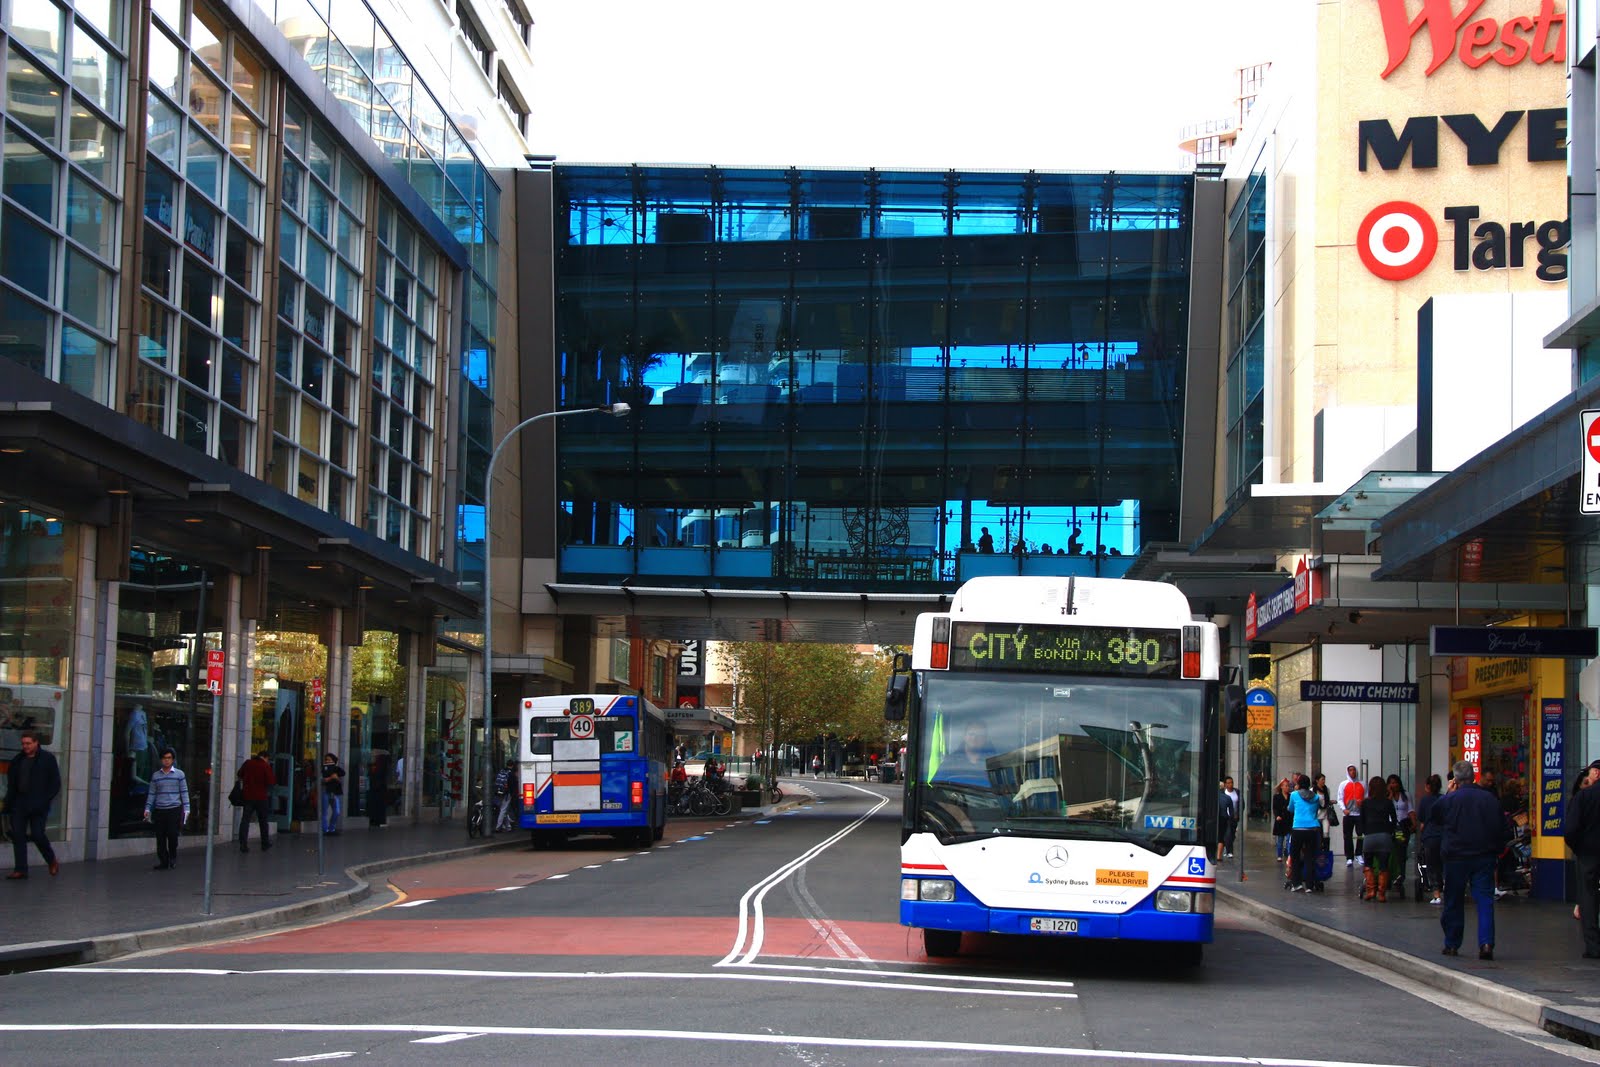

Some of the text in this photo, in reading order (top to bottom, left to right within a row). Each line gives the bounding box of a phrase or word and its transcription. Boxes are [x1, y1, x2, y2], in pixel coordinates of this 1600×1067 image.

[1358, 107, 1567, 172] MYE
[1444, 205, 1569, 282] Targ
[969, 632, 1029, 660] CITY
[1056, 637, 1081, 649] VIA
[681, 640, 698, 676] UIK
[1034, 648, 1101, 662] BONDI JN
[1107, 637, 1160, 666] 380
[1475, 658, 1528, 683] PRESCRIPTIONS
[1308, 684, 1414, 699] DISCOUNT CHEMIST
[573, 701, 592, 713] 389
[574, 720, 591, 732] 40
[1464, 733, 1480, 749] 85%
[1464, 751, 1479, 762] OFF
[1545, 752, 1561, 767] OFF
[1150, 816, 1169, 828] W
[1045, 878, 1068, 886] Sydney
[1096, 877, 1148, 886] SIGNAL DRIVER
[1052, 920, 1077, 932] 1270
